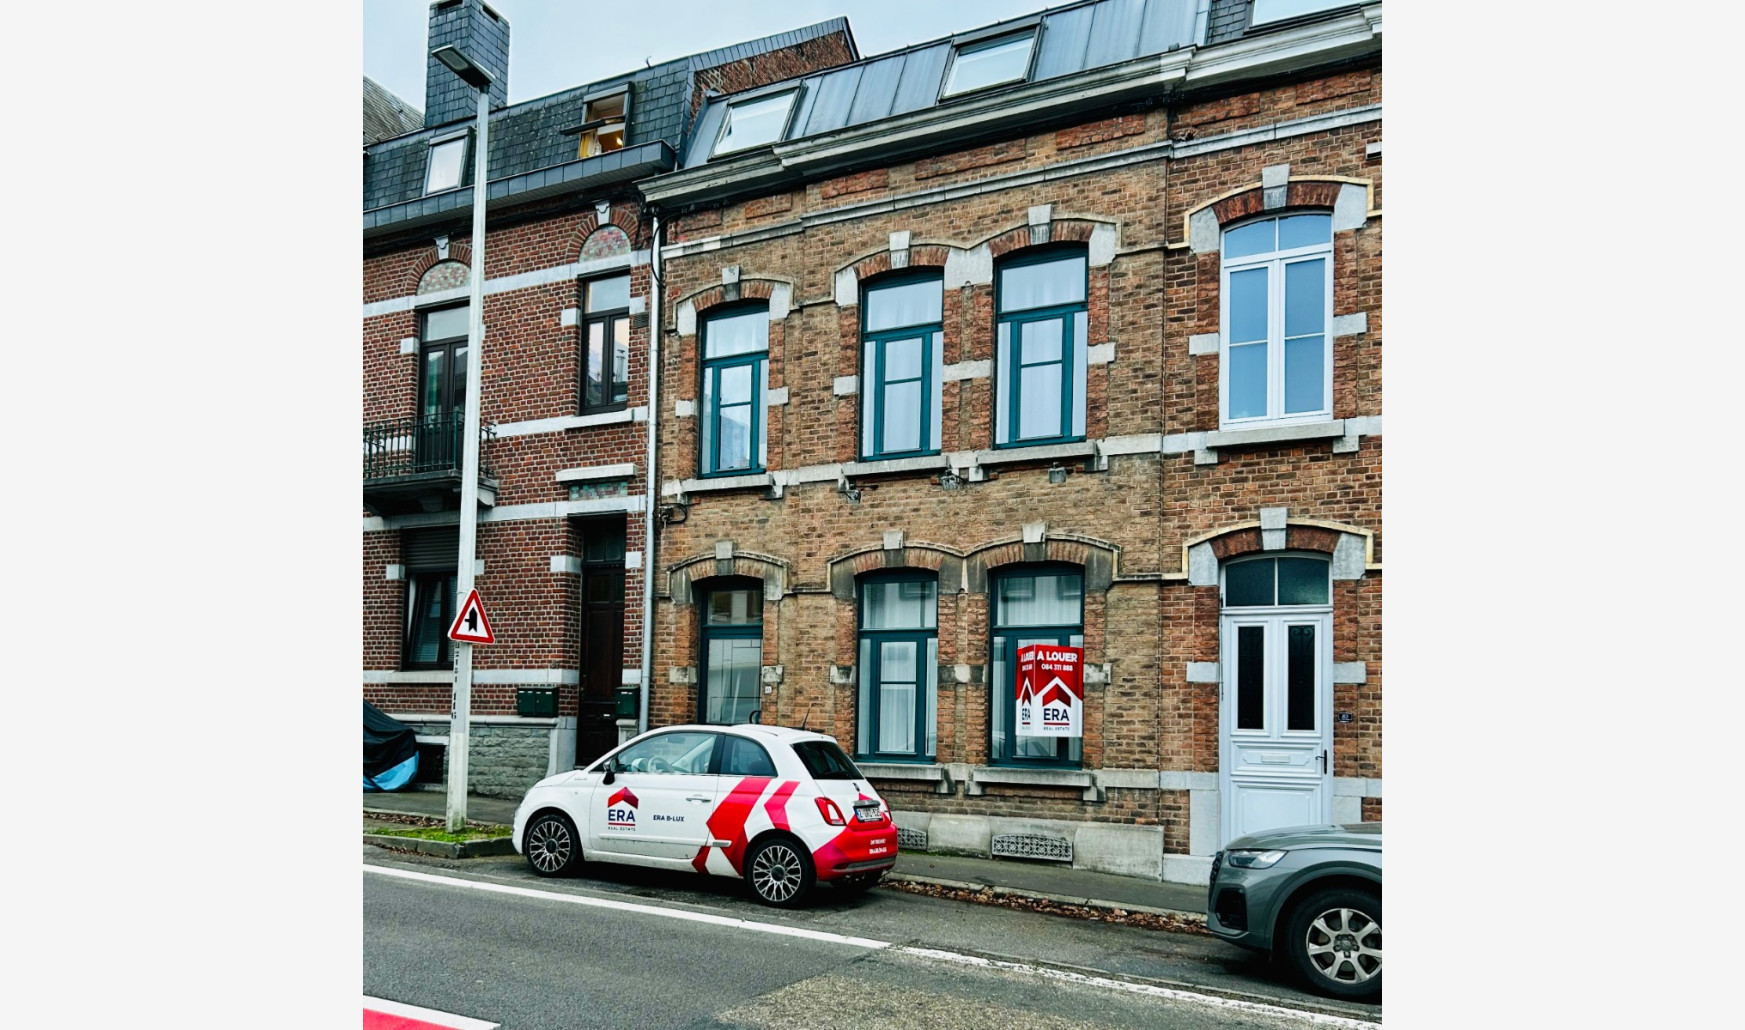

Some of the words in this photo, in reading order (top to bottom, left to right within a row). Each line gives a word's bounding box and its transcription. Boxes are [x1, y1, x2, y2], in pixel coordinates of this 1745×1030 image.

[1036, 650, 1045, 660] A
[1046, 651, 1078, 662] LOUER
[1022, 708, 1031, 720] ERA
[1043, 708, 1070, 721] ERA
[608, 809, 636, 822] ERA
